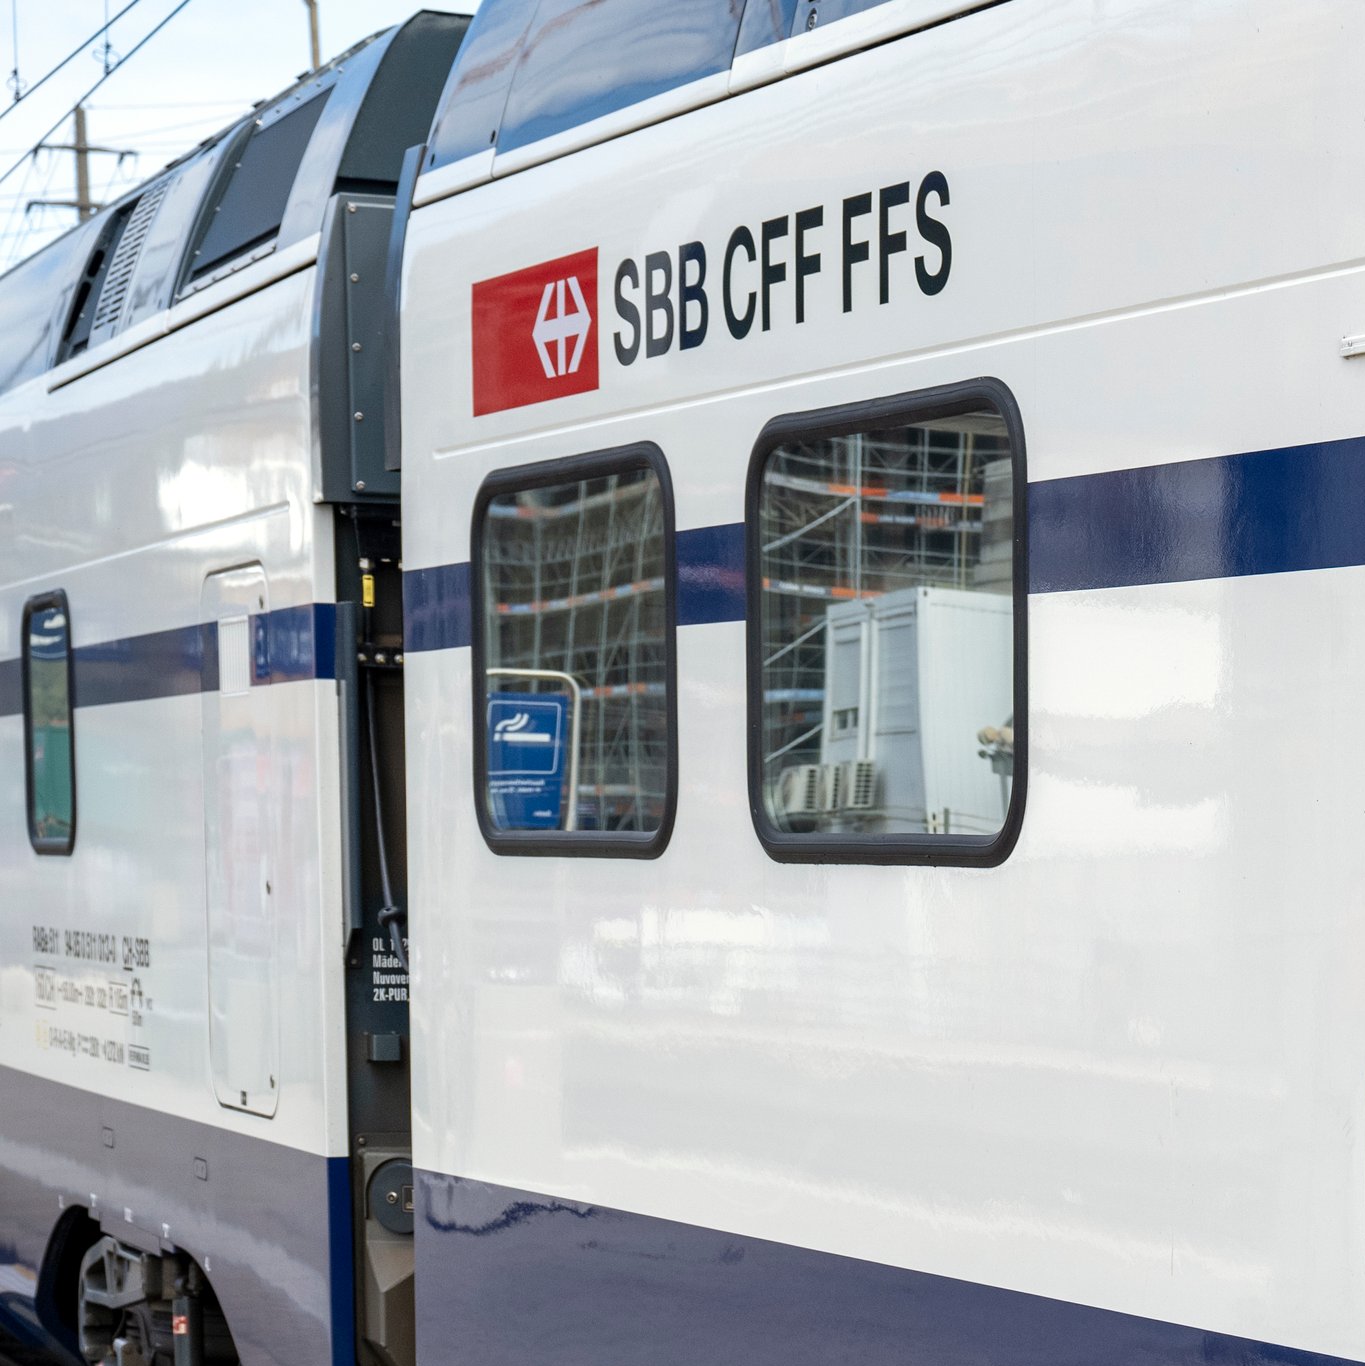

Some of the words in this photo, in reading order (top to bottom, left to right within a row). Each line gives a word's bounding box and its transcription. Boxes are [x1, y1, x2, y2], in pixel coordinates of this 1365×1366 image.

[613, 240, 709, 366] SBB
[723, 205, 824, 340] CFF
[842, 170, 952, 313] FFS
